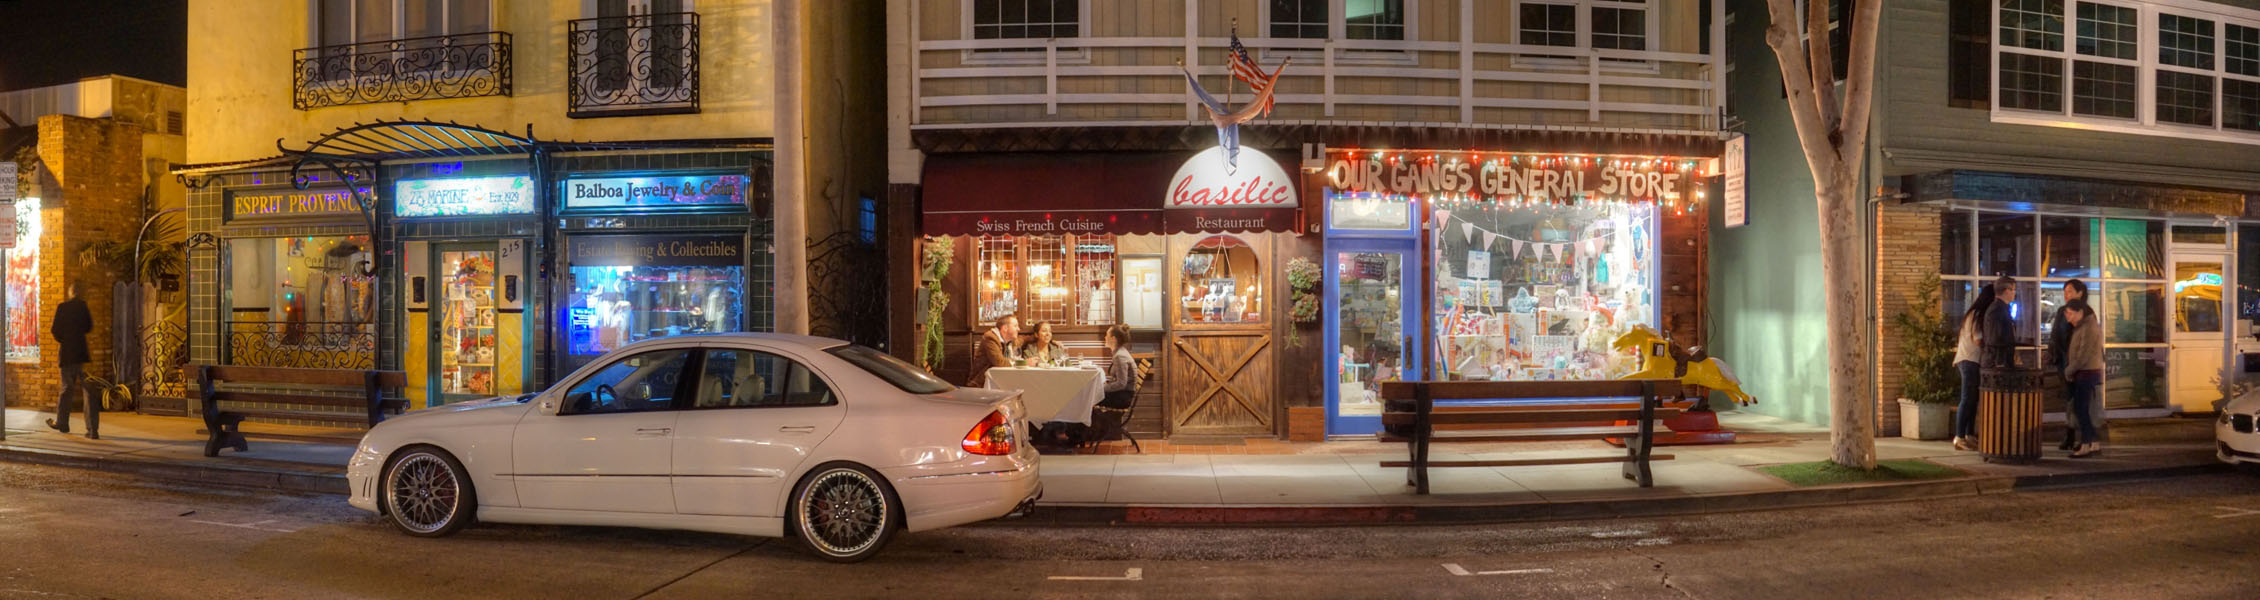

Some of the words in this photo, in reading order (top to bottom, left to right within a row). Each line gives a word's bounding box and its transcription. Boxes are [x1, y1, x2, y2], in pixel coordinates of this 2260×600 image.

[1333, 159, 1386, 192] OUR
[1390, 161, 1474, 193] GANGS
[1479, 164, 1595, 199] GENERAL
[1598, 166, 1681, 200] STORE
[427, 188, 469, 205] MARINE
[575, 183, 623, 199] Balboa
[625, 181, 679, 202] Jewelry
[682, 180, 696, 196] &
[700, 178, 736, 196] Coin
[1172, 174, 1289, 206] basilic
[235, 194, 283, 215] ESPRIT
[976, 219, 1010, 232] Swiss
[1015, 219, 1055, 232] French
[1060, 218, 1104, 231] Cuisine
[1195, 216, 1265, 229] Restaurant
[502, 240, 520, 259] 215
[577, 242, 610, 257] Estate
[656, 242, 667, 257] &
[670, 240, 737, 257] Collectibles
